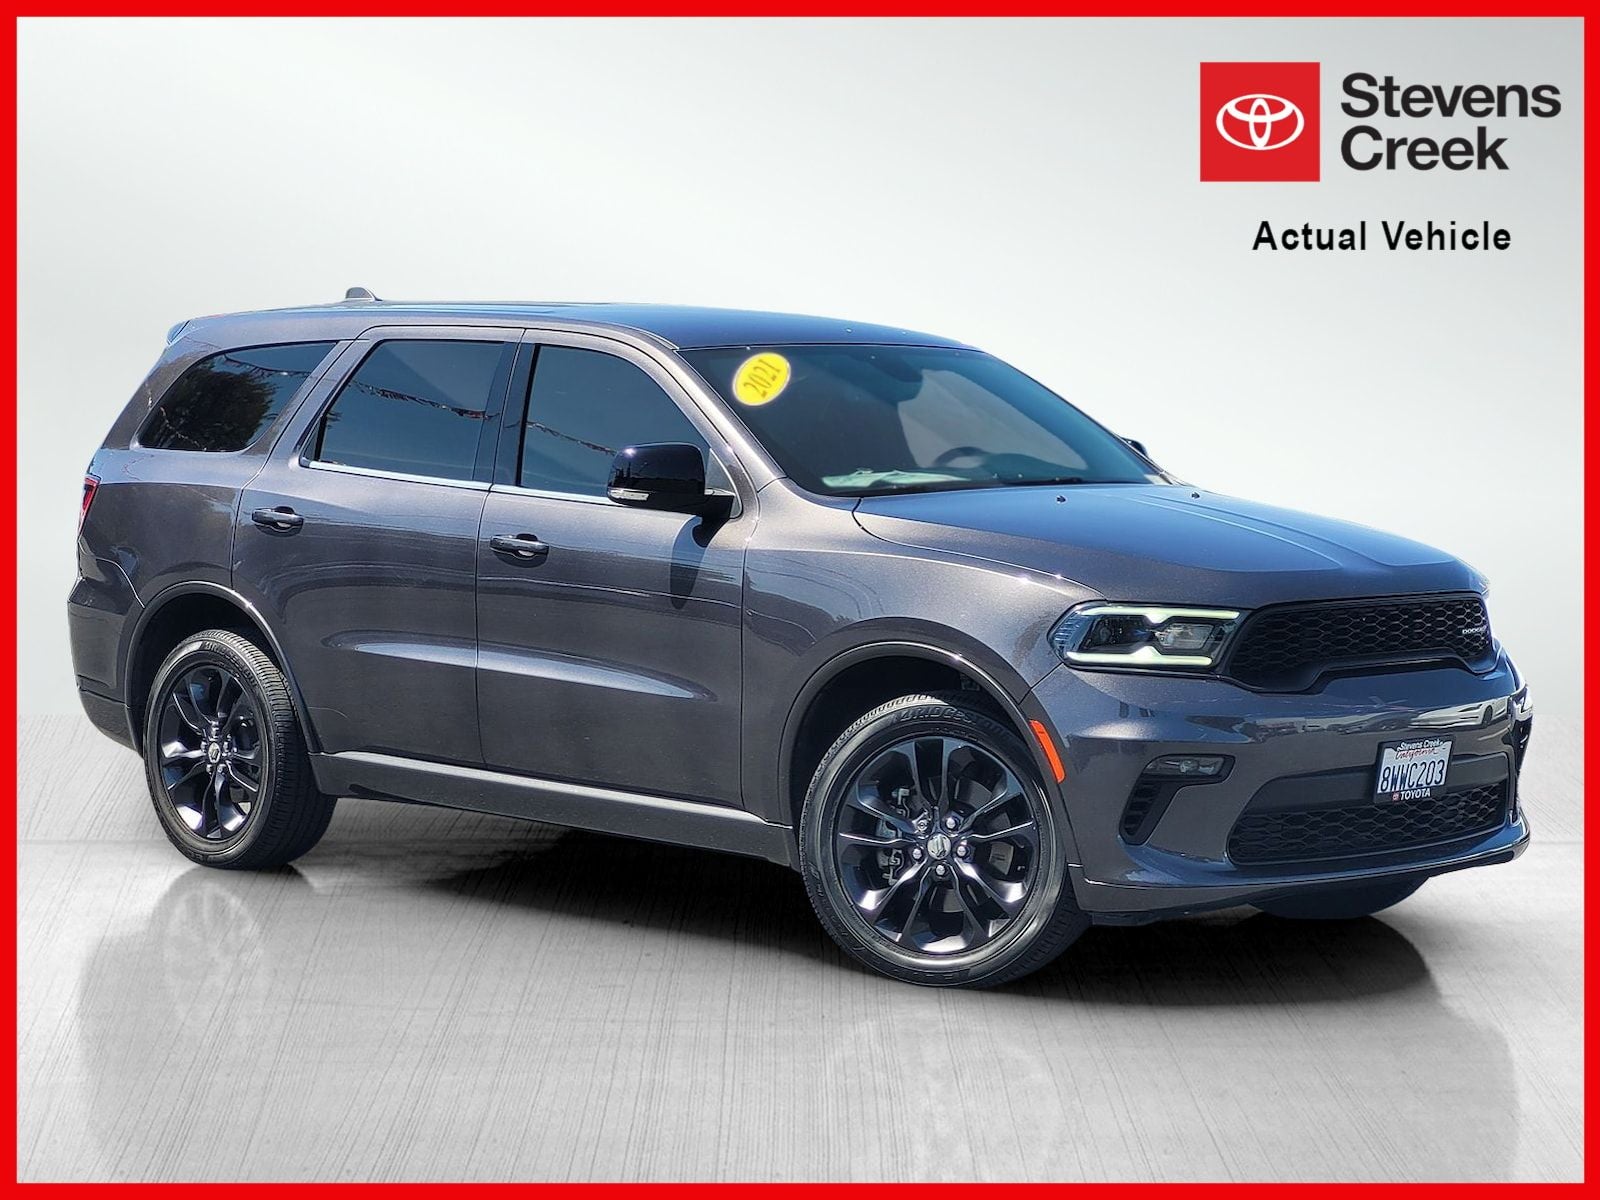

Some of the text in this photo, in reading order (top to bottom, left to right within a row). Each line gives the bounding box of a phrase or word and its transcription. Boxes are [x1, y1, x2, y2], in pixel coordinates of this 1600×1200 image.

[743, 359, 781, 398] 2021
[1381, 760, 1445, 791] 8WWC203
[1401, 788, 1431, 801] TOYOTA
